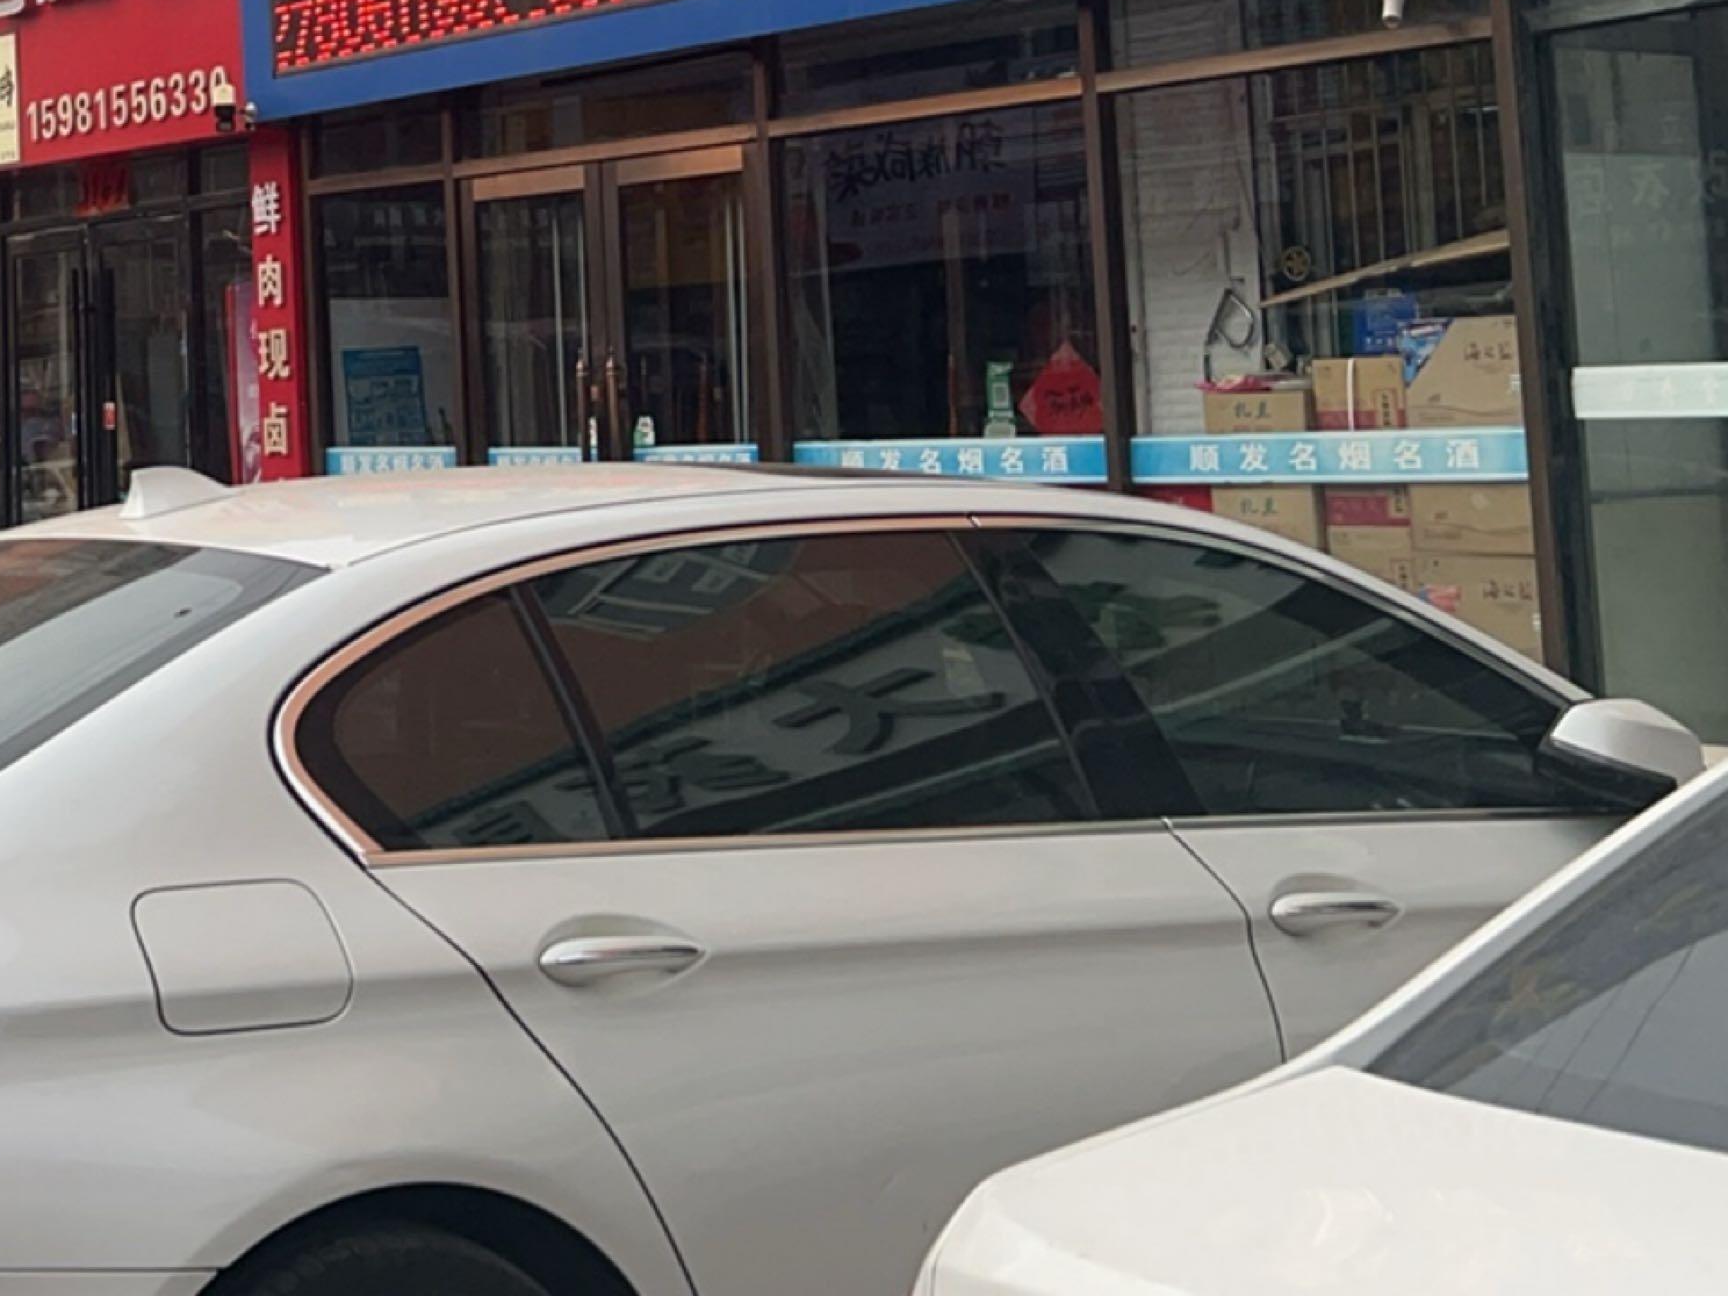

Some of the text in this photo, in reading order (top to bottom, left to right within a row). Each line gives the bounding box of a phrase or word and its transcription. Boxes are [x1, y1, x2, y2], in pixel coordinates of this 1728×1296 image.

[841, 445, 1069, 474] 顺发名烟名酒
[1190, 439, 1479, 472] 顺发名烟名酒
